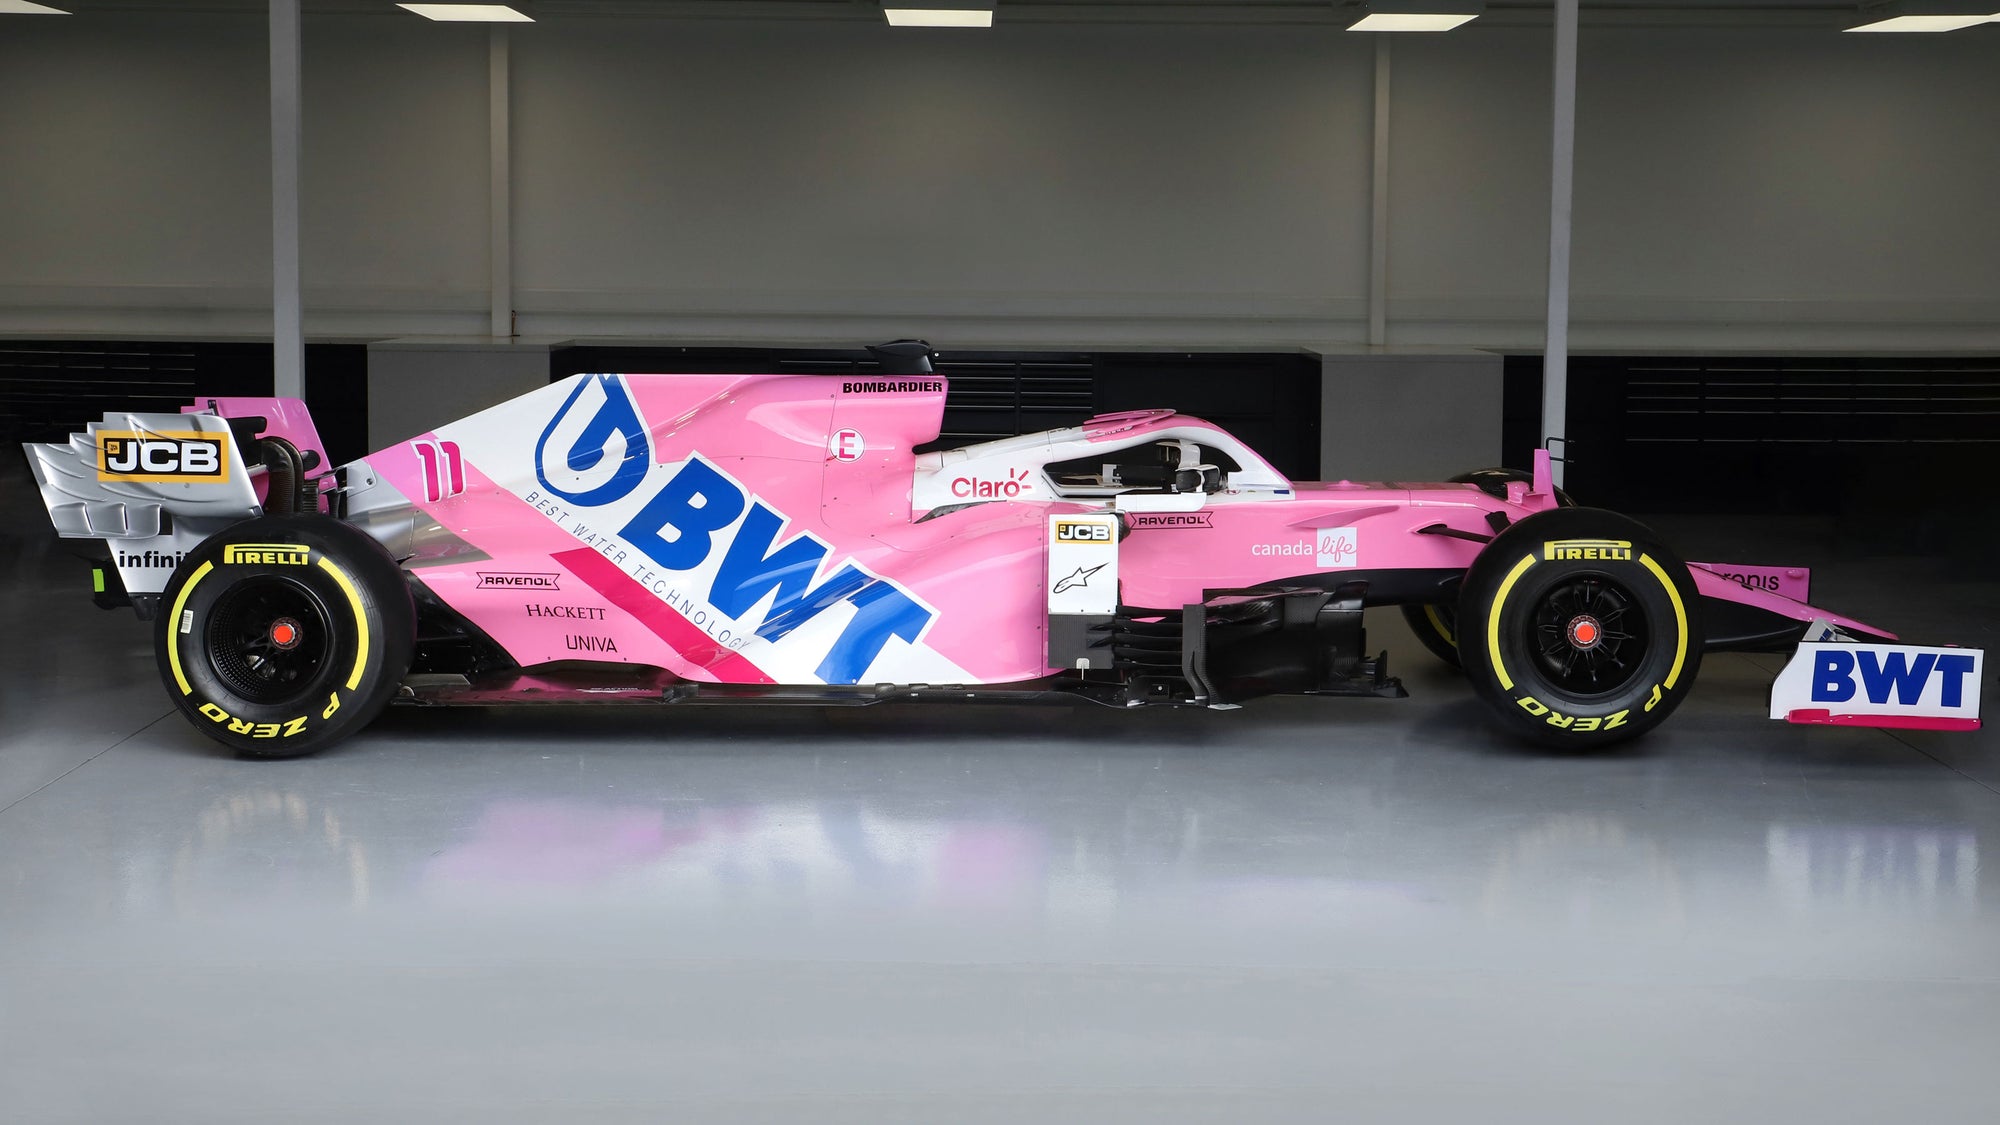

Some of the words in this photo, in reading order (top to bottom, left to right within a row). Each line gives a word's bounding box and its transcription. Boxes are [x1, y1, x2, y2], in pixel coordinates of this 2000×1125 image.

[842, 382, 943, 394] BOMBARDIER
[107, 441, 219, 472] JCB
[838, 432, 856, 459] E
[412, 440, 466, 503] 11
[951, 476, 1021, 498] Claro
[1059, 525, 1110, 540] JCB
[1138, 516, 1205, 526] RAVENOL
[119, 550, 190, 568] infini
[223, 543, 311, 566] PIRELLI
[1251, 539, 1313, 556] canada
[1317, 536, 1357, 563] life
[1544, 539, 1632, 560] PIRELLI
[485, 576, 553, 586] RAVENOL
[525, 491, 570, 523] BEST
[572, 523, 627, 564] WATER
[632, 564, 751, 650] TECHNOLOGY
[617, 457, 932, 685] BWT
[526, 604, 606, 620] HACKETT
[565, 634, 618, 653] UNIVA
[1811, 650, 1975, 708] BWT
[322, 691, 341, 720] P
[1644, 683, 1663, 712] P
[198, 702, 308, 738] ZERO
[1516, 696, 1630, 731] ZERO
